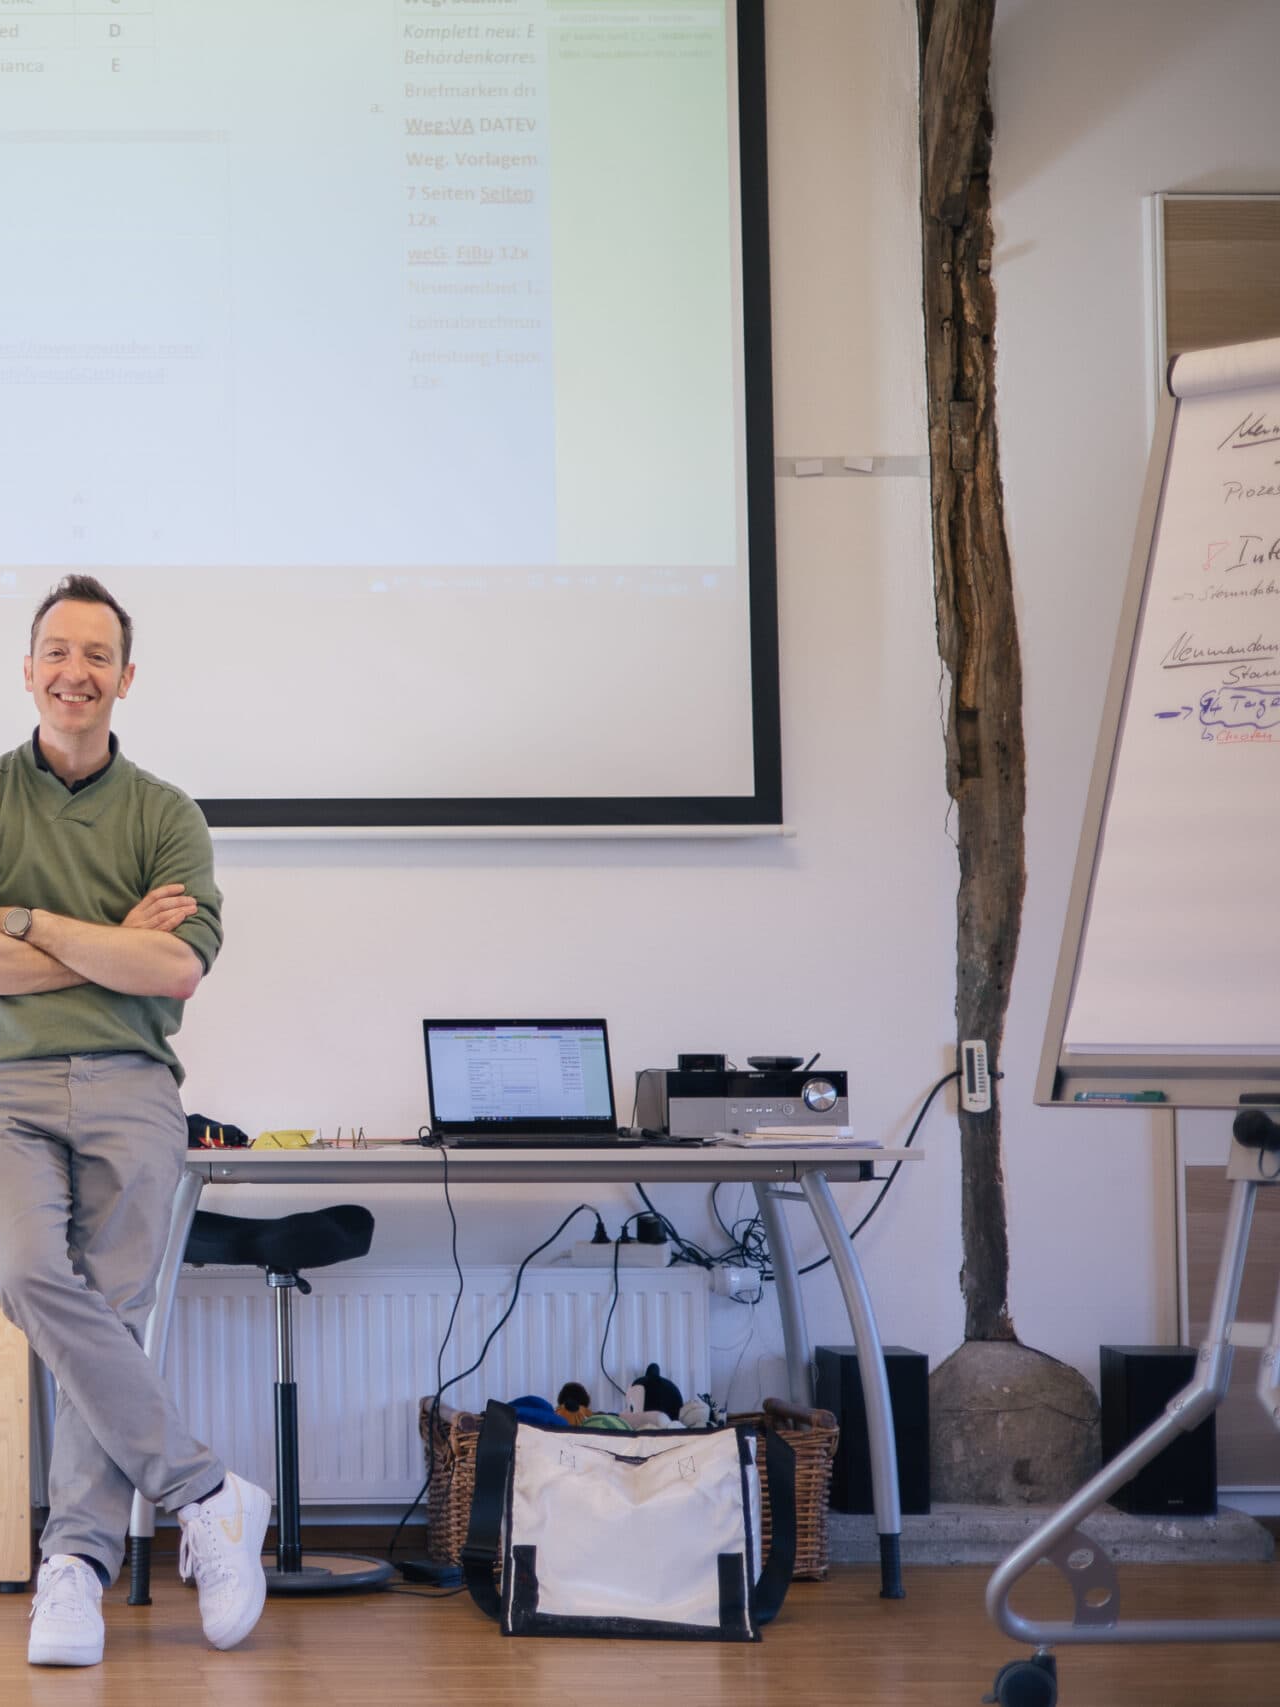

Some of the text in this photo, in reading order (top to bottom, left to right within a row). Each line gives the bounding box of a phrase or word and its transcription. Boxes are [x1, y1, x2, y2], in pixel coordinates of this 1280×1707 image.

[109, 25, 121, 39] D
[403, 23, 479, 41] Komplett
[111, 59, 121, 74] E
[404, 82, 508, 98] Briefmarken
[480, 117, 537, 133] DATEV
[407, 187, 416, 202] 7
[421, 186, 475, 202] Seiten
[408, 212, 438, 227] 12x
